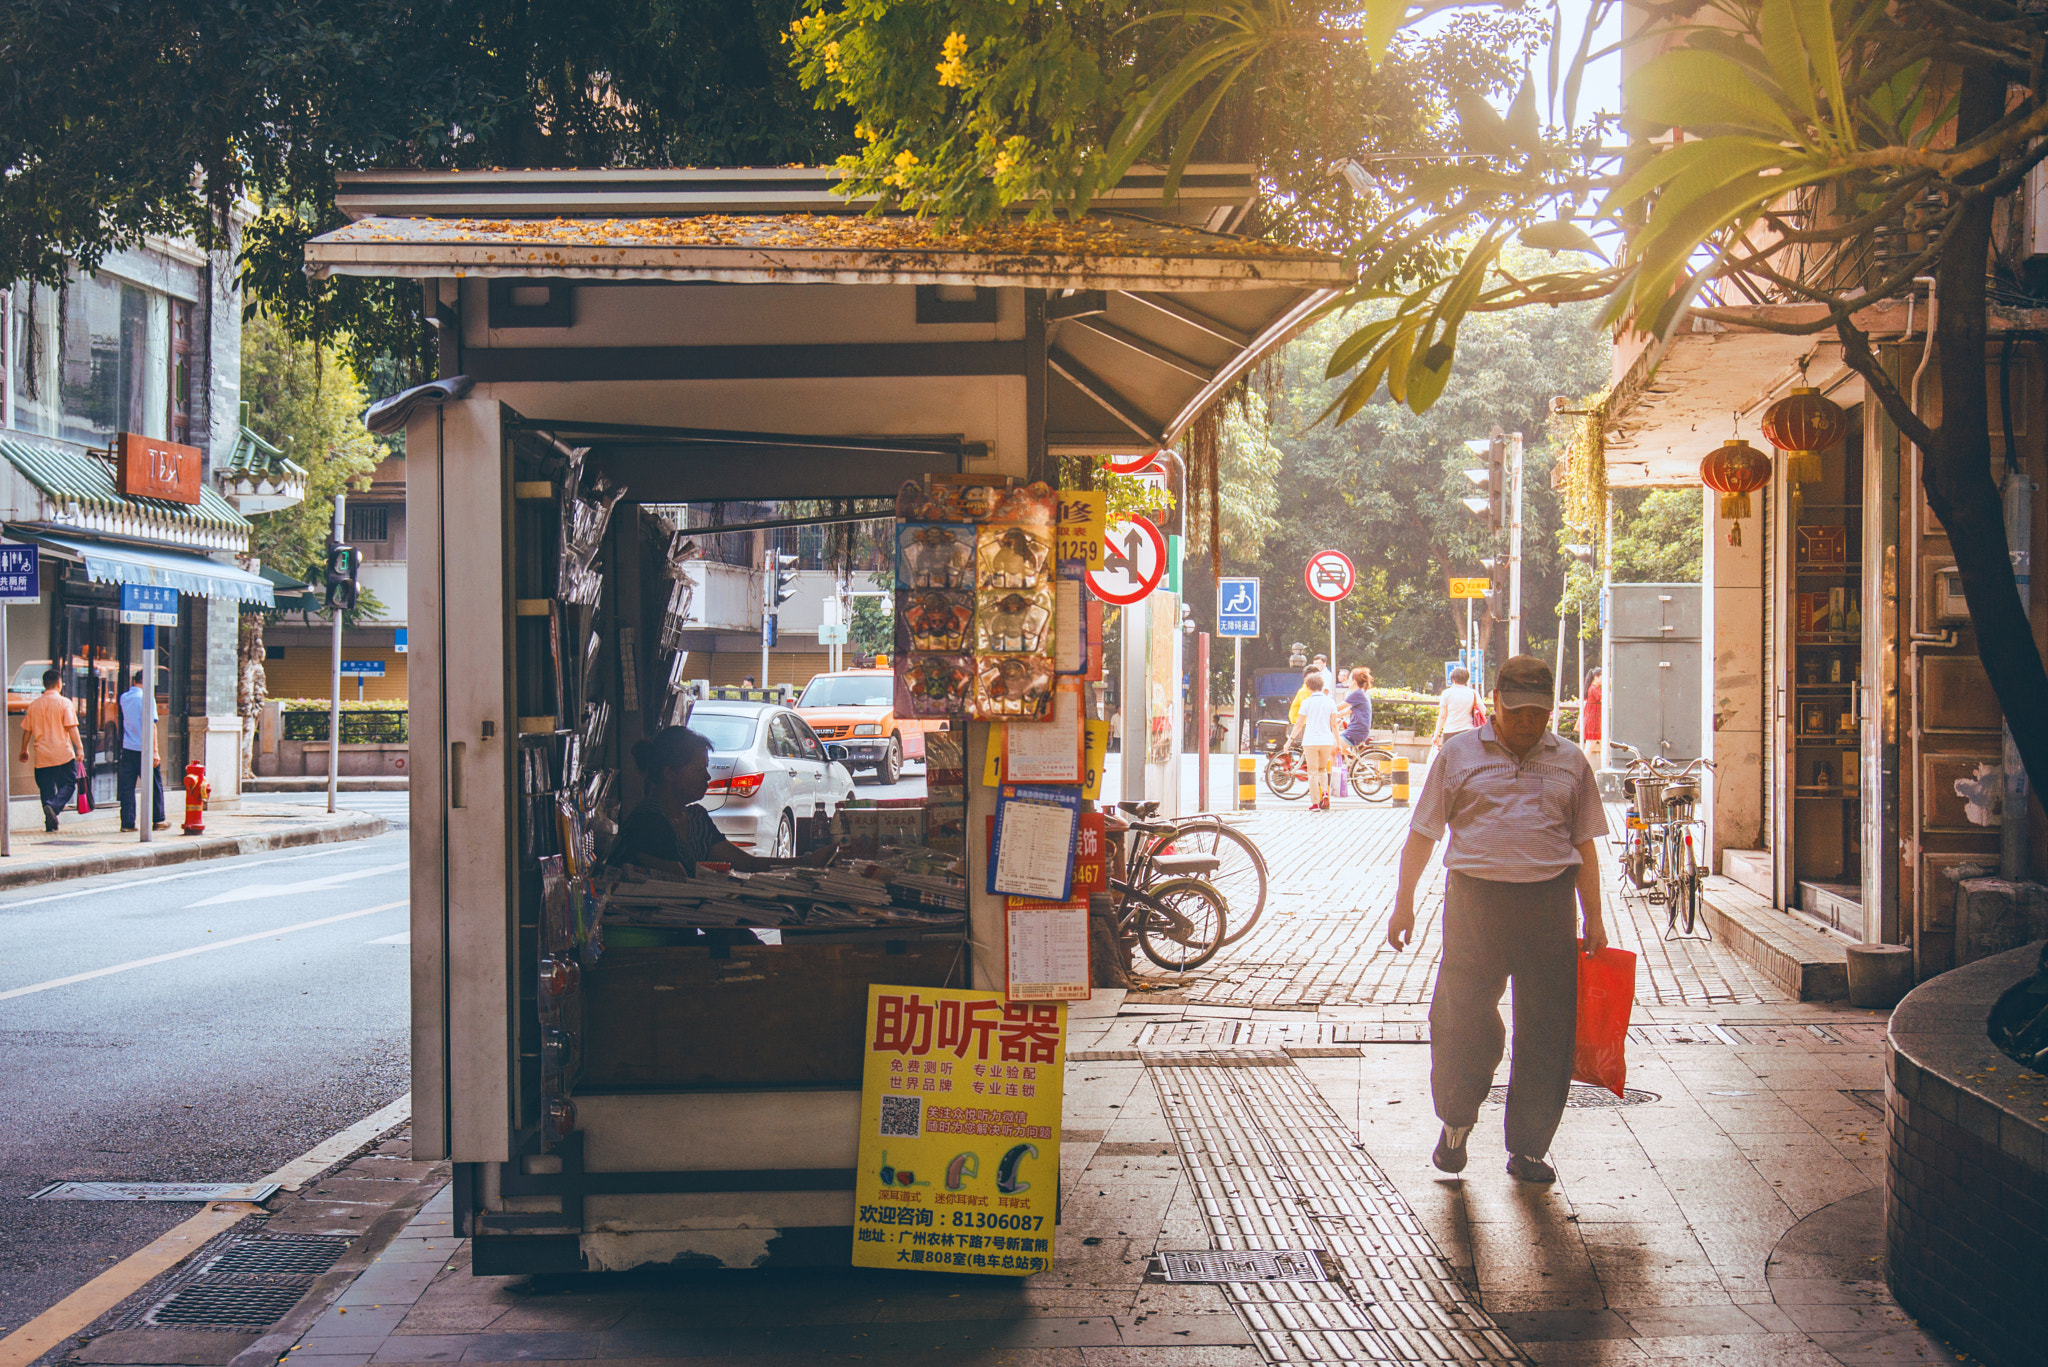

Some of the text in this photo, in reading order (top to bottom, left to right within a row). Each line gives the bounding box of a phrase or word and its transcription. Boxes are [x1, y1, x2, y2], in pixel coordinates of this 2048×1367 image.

[1056, 540, 1098, 562] 1259
[1220, 620, 1256, 631] 无障碍通道
[872, 993, 1061, 1065] 助听器
[890, 1058, 1037, 1081] 免费测听 专业验配
[889, 1075, 1036, 1098] 世界品牌 专业连锁
[926, 1106, 1028, 1125] 关注众悦听力微信
[925, 1119, 1052, 1140] 随时为您解决听力问题
[878, 1189, 1031, 1210] 深耳道式 迷你耳背式 耳背式
